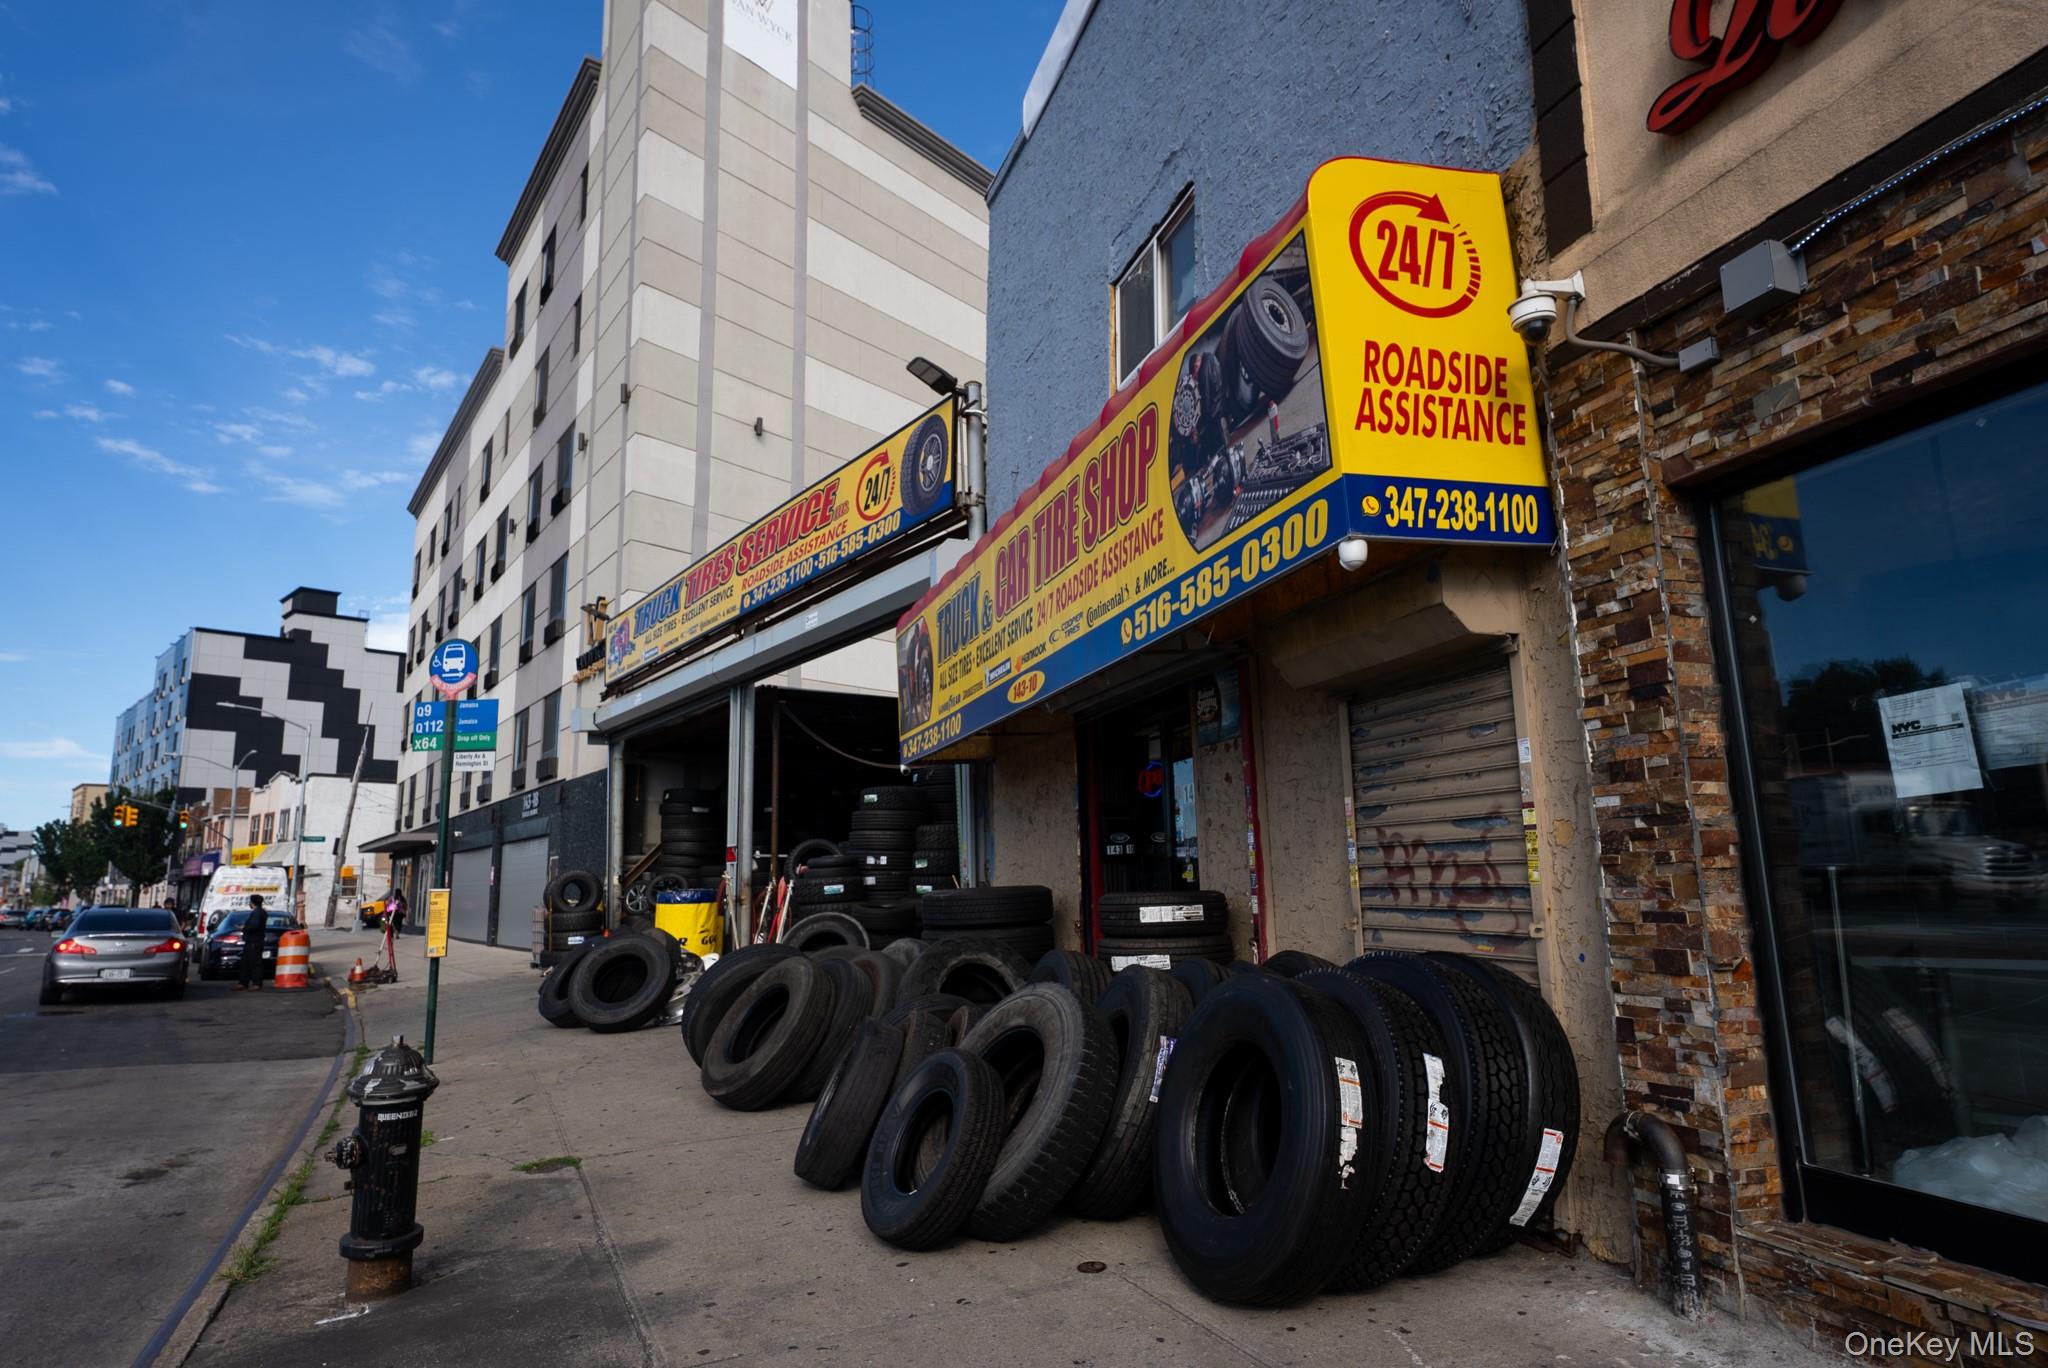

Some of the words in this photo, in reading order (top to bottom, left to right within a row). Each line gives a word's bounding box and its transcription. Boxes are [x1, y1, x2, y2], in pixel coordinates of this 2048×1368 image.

[758, 11, 793, 42] WYCK
[1377, 219, 1455, 291] 24/7
[1364, 339, 1508, 398] ROADSIDE
[1354, 387, 1526, 446] ASSISTANCE
[864, 466, 891, 512] 24/7
[1385, 485, 1538, 534] 347-238-1100
[634, 576, 685, 639] TRUCK
[684, 542, 737, 609] TIRES
[736, 477, 840, 575] SERVICE
[741, 558, 785, 592] ROADSIDE
[787, 519, 848, 564] ASSISTANCE
[752, 558, 814, 605] 347-238-1100
[818, 511, 901, 570] 516-585-0300
[936, 570, 981, 668] TRUCK
[982, 590, 994, 634] &
[995, 525, 1030, 622] CAR
[1032, 475, 1080, 592] TIRE
[1082, 402, 1159, 553] SHOP
[1134, 498, 1328, 641] 516-585-0300
[1135, 577, 1141, 594] &
[653, 627, 662, 640] SIZE
[664, 618, 677, 633] TIRES
[682, 599, 709, 624] EXCELLENT
[710, 585, 734, 608] SERVICE
[940, 669, 948, 690] ALL
[948, 661, 958, 687] SIZE
[959, 651, 973, 679] TIRES
[976, 626, 1006, 667] EXCELLENT
[1007, 608, 1033, 647] SERVICE
[1037, 592, 1054, 628] 24/7
[1055, 556, 1098, 614] ROADSIDE
[1101, 508, 1164, 582] ASSISTANCE
[417, 704, 432, 717] Q9
[1013, 678, 1038, 701] 143-10
[416, 720, 443, 733] Q112
[907, 713, 962, 757] 347-238-1100
[1891, 720, 1921, 733] NYC
